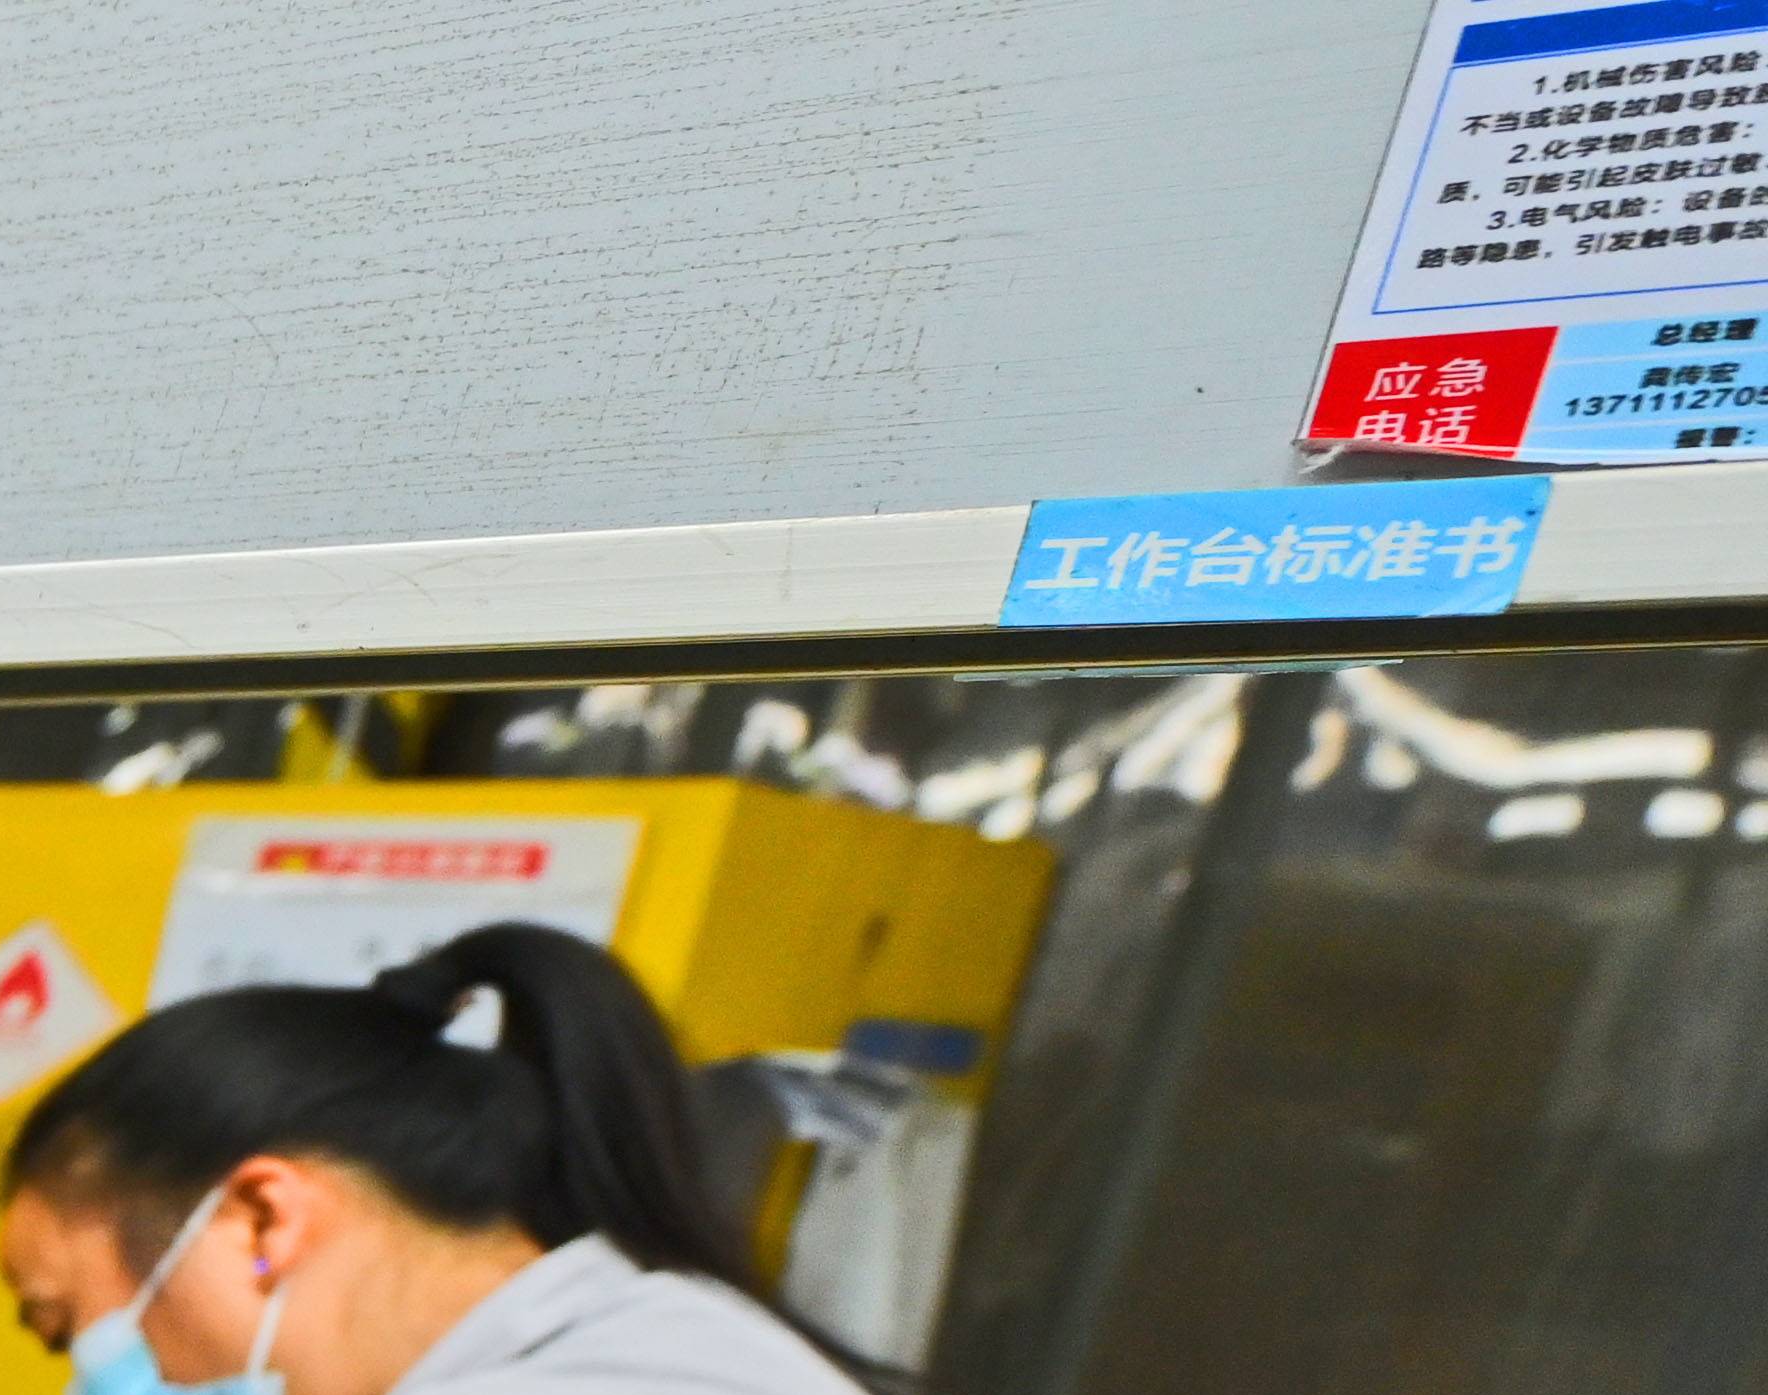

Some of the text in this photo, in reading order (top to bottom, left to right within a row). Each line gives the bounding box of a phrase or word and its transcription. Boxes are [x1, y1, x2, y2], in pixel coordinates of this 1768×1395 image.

[1364, 356, 1488, 402] 应急
[1351, 405, 1478, 446] 电话
[1023, 516, 1526, 590] 工作台标准书
